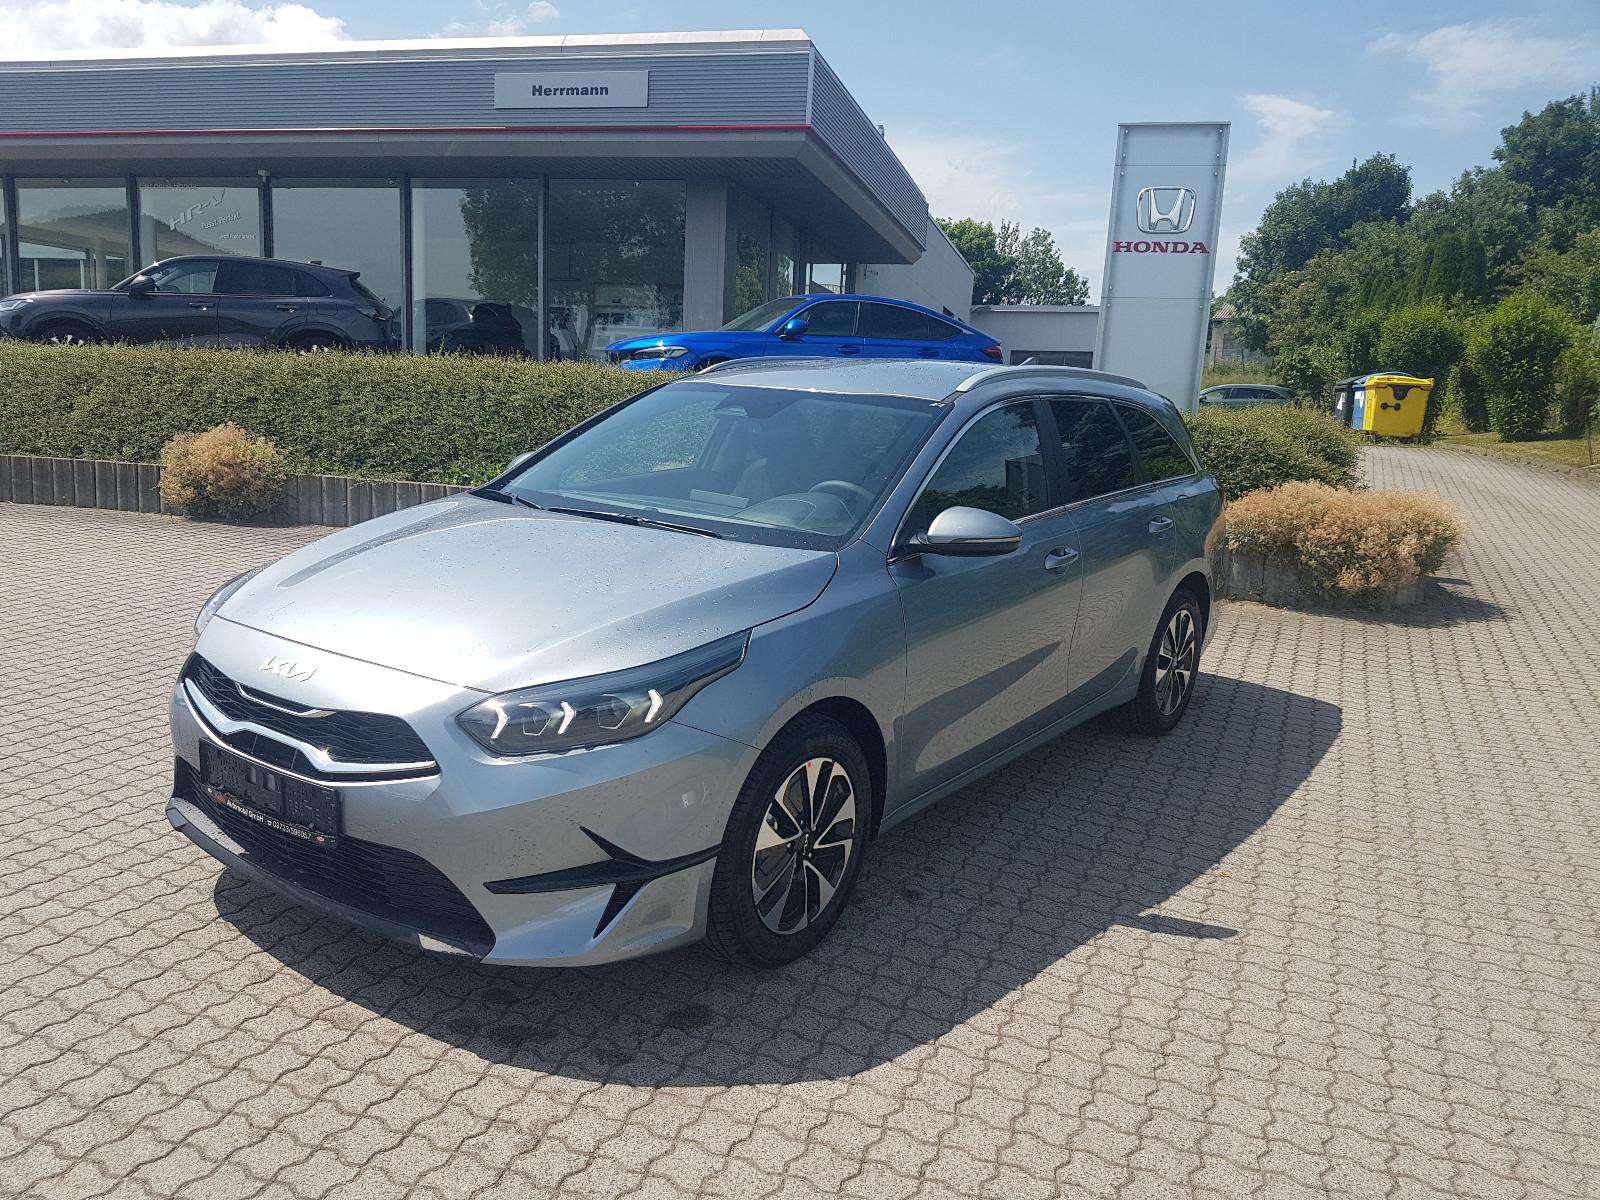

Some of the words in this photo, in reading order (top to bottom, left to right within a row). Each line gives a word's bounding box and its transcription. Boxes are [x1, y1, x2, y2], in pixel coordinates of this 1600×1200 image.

[531, 84, 609, 97] Herrmann
[169, 188, 227, 231] HR-V
[1113, 241, 1210, 254] HONDA
[248, 810, 264, 823] GmbH
